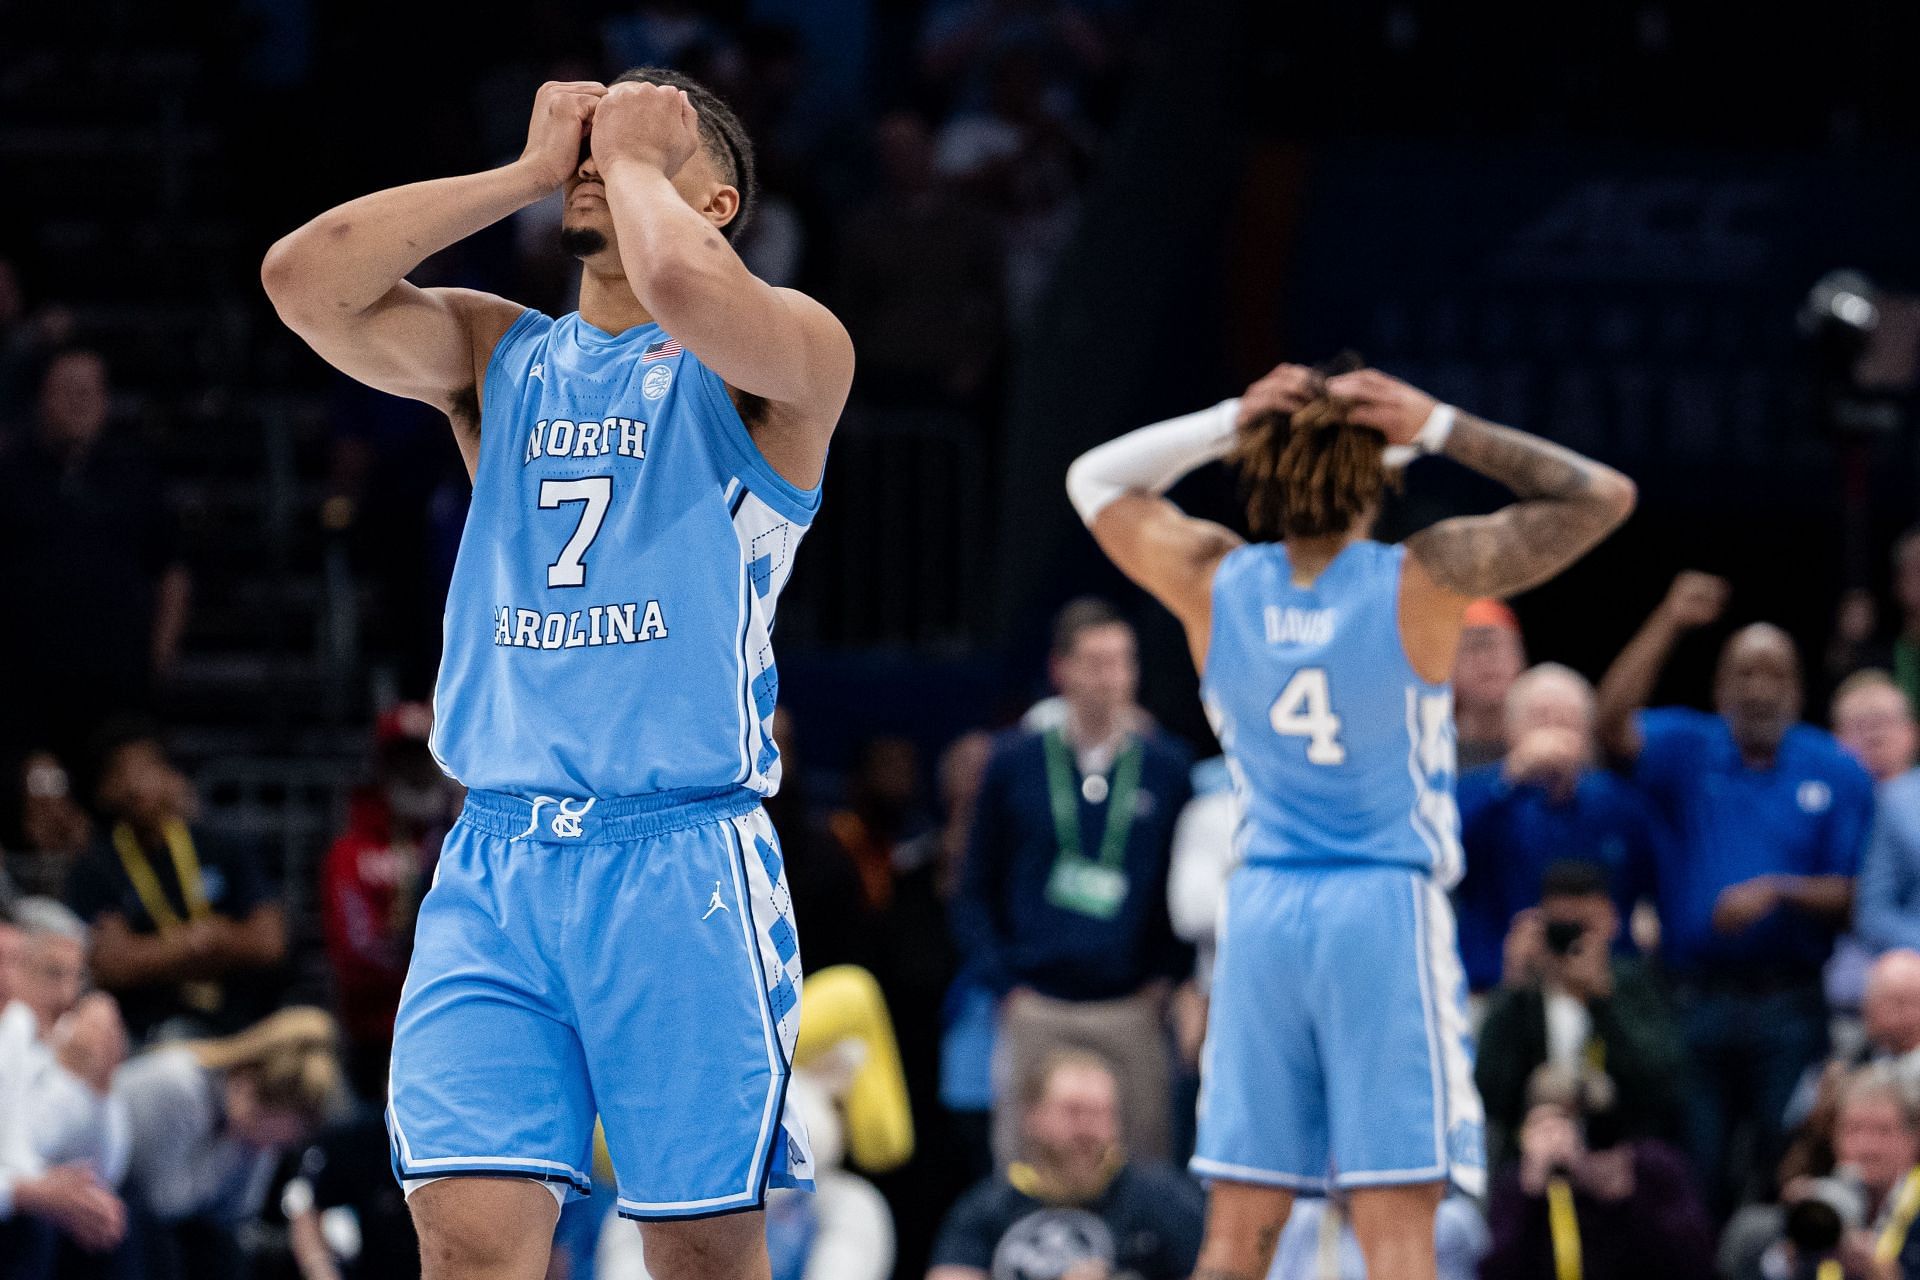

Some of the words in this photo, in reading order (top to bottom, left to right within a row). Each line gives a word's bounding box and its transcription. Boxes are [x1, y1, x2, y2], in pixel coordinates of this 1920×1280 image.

[524, 417, 647, 466] NORTH
[537, 475, 613, 589] 7
[1269, 667, 1345, 766] 4
